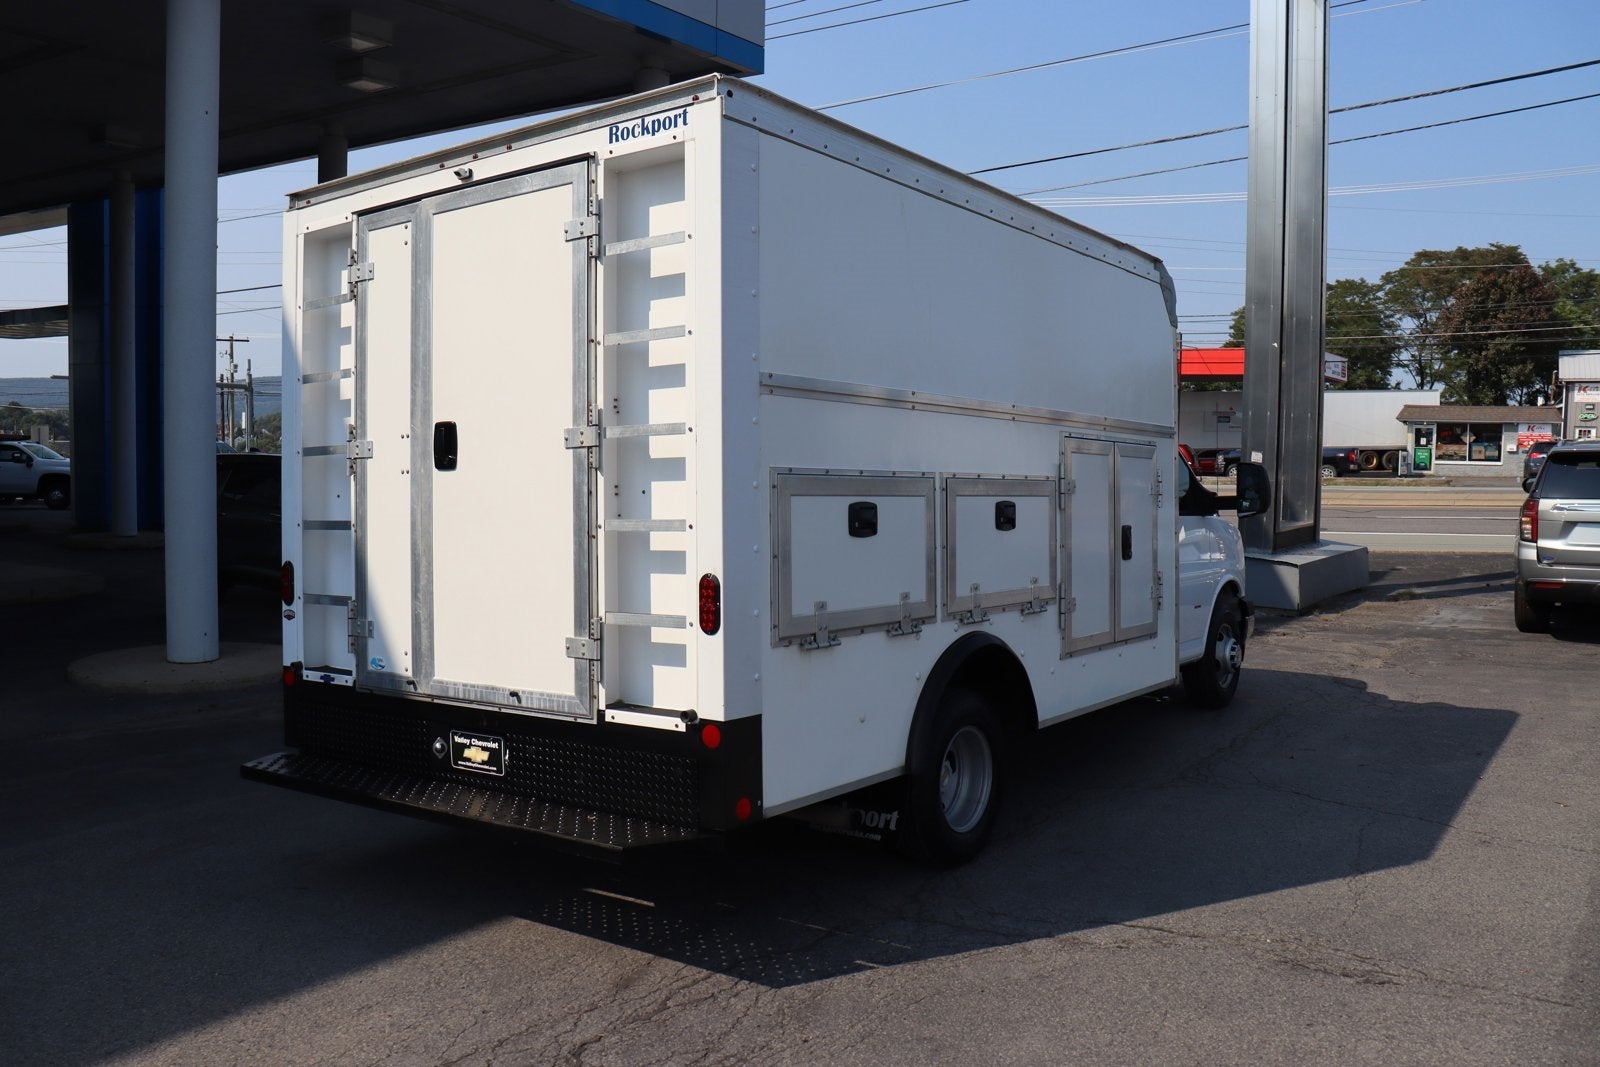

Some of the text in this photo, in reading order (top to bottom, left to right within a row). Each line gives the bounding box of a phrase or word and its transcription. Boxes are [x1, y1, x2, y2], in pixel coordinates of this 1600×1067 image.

[609, 108, 688, 144] Rockport
[454, 735, 499, 749] Valley Chevrolet
